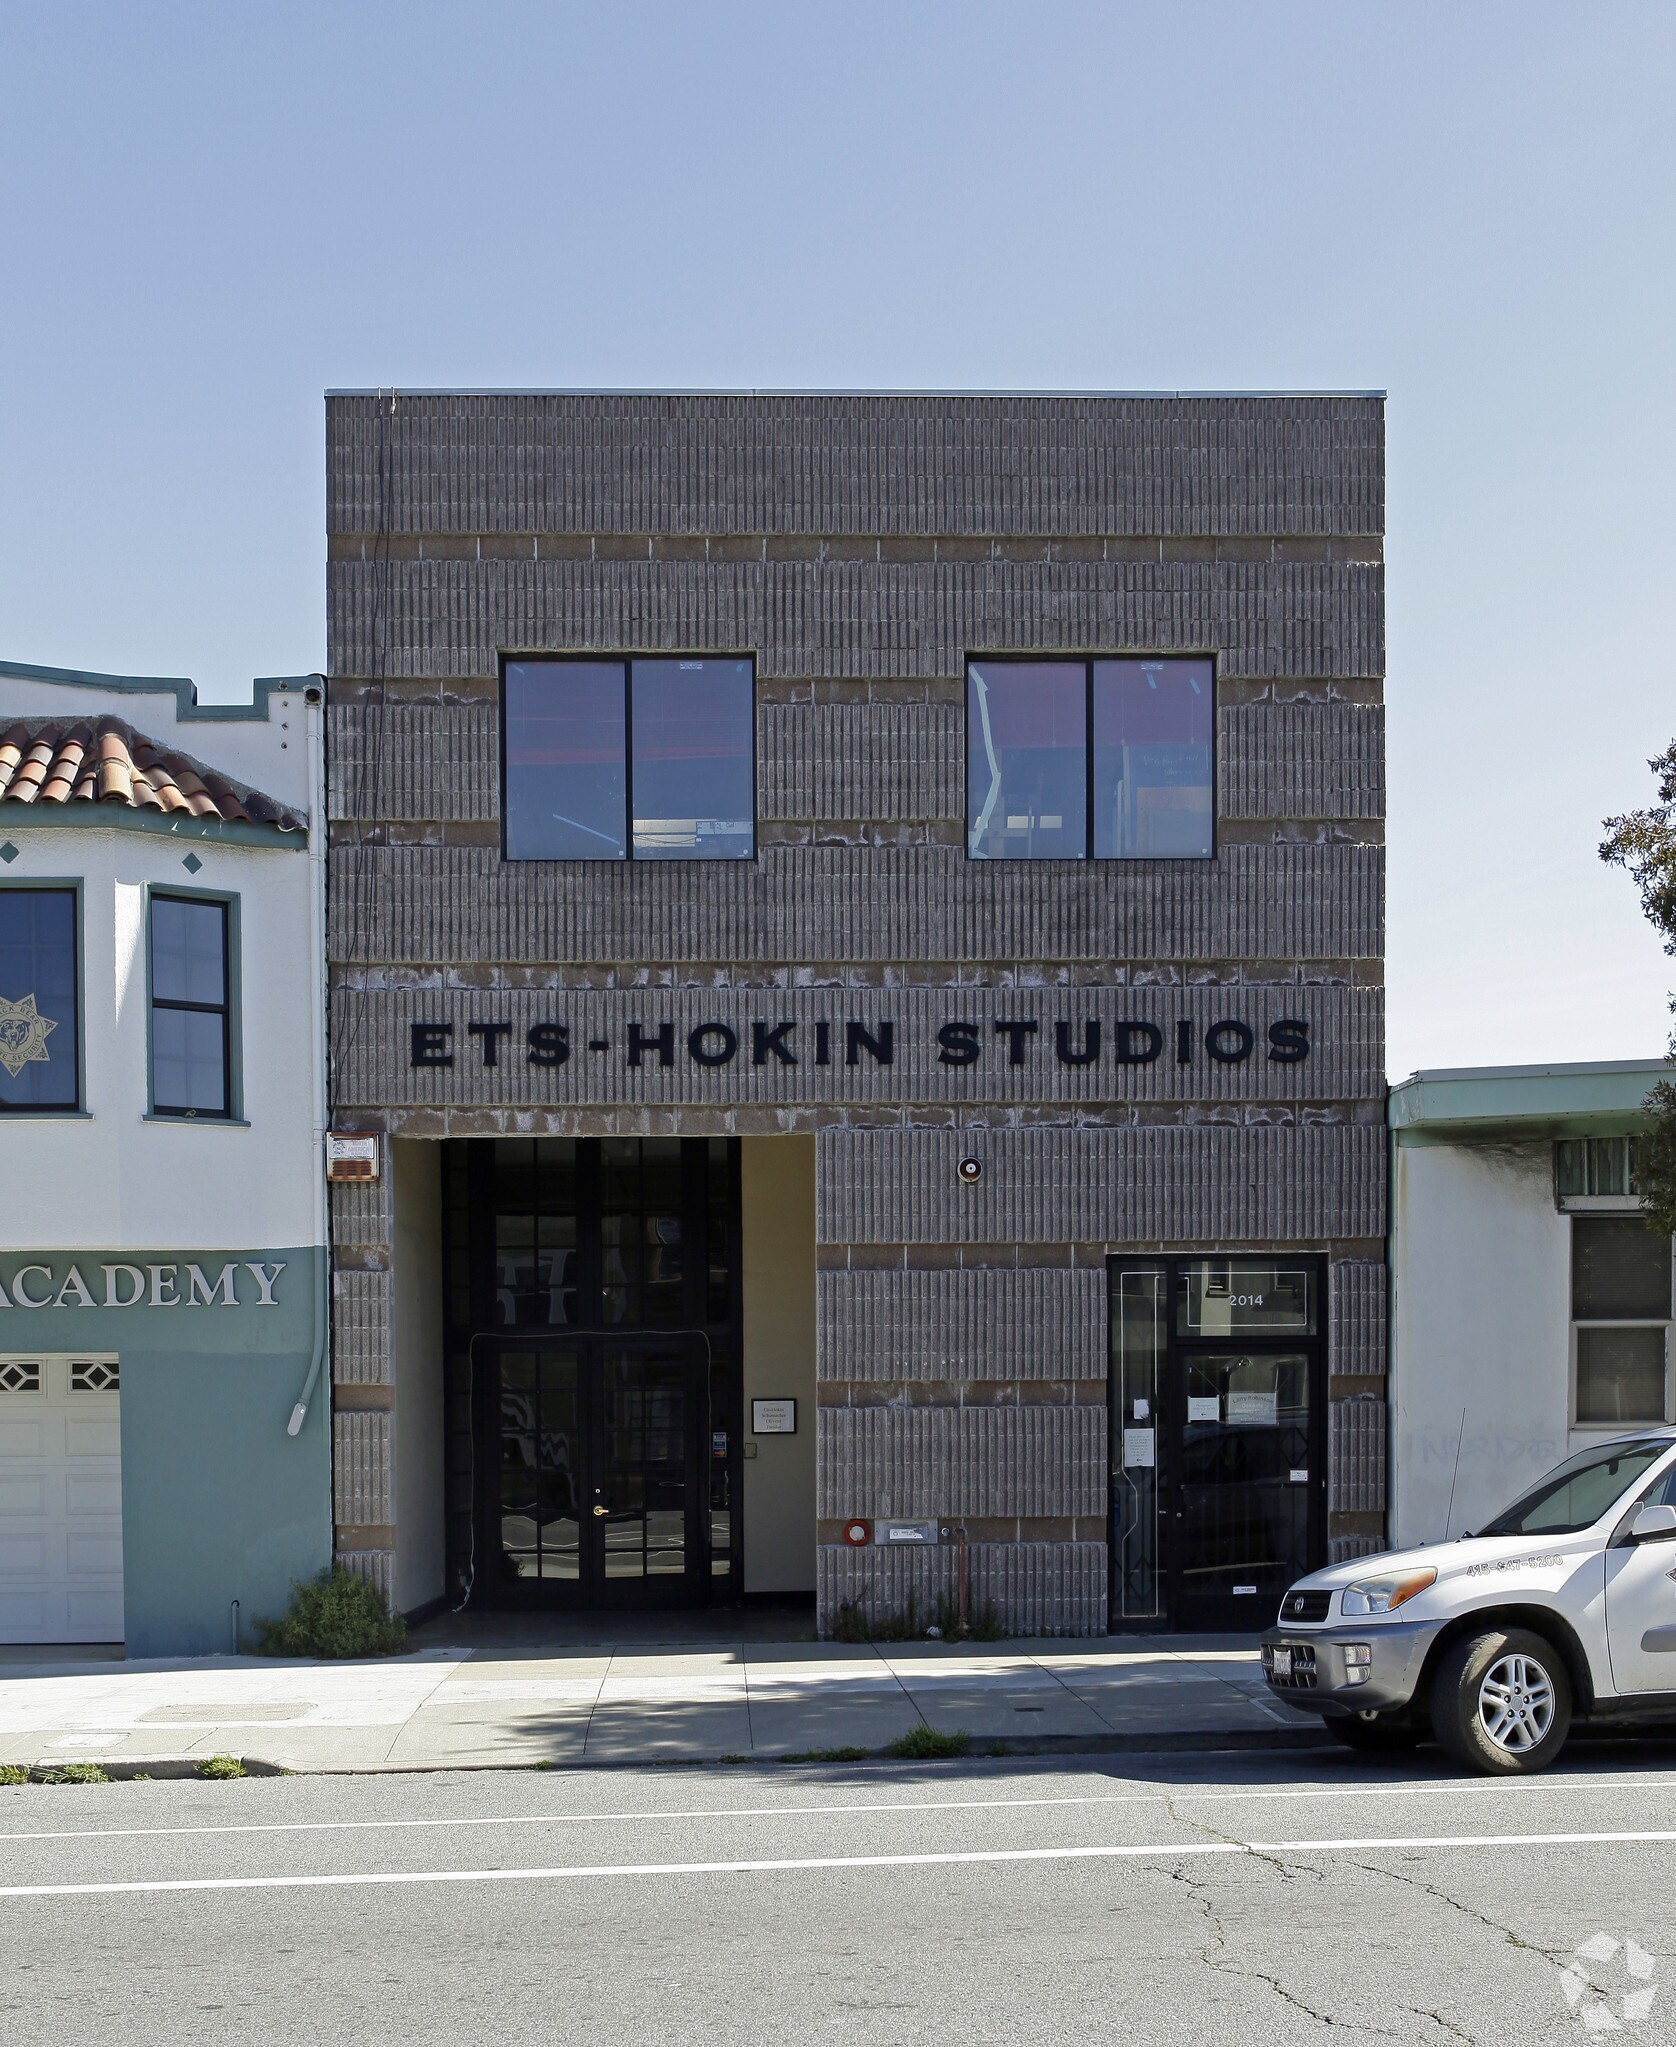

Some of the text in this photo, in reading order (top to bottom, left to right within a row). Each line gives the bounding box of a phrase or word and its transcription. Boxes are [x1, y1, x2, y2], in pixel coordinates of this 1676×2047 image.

[20, 1007, 39, 1025] BEAR
[12, 1033, 42, 1061] SECURITY
[410, 1020, 1310, 1067] ETS-HOKIN STUDIOS
[1229, 1294, 1264, 1306] 2014
